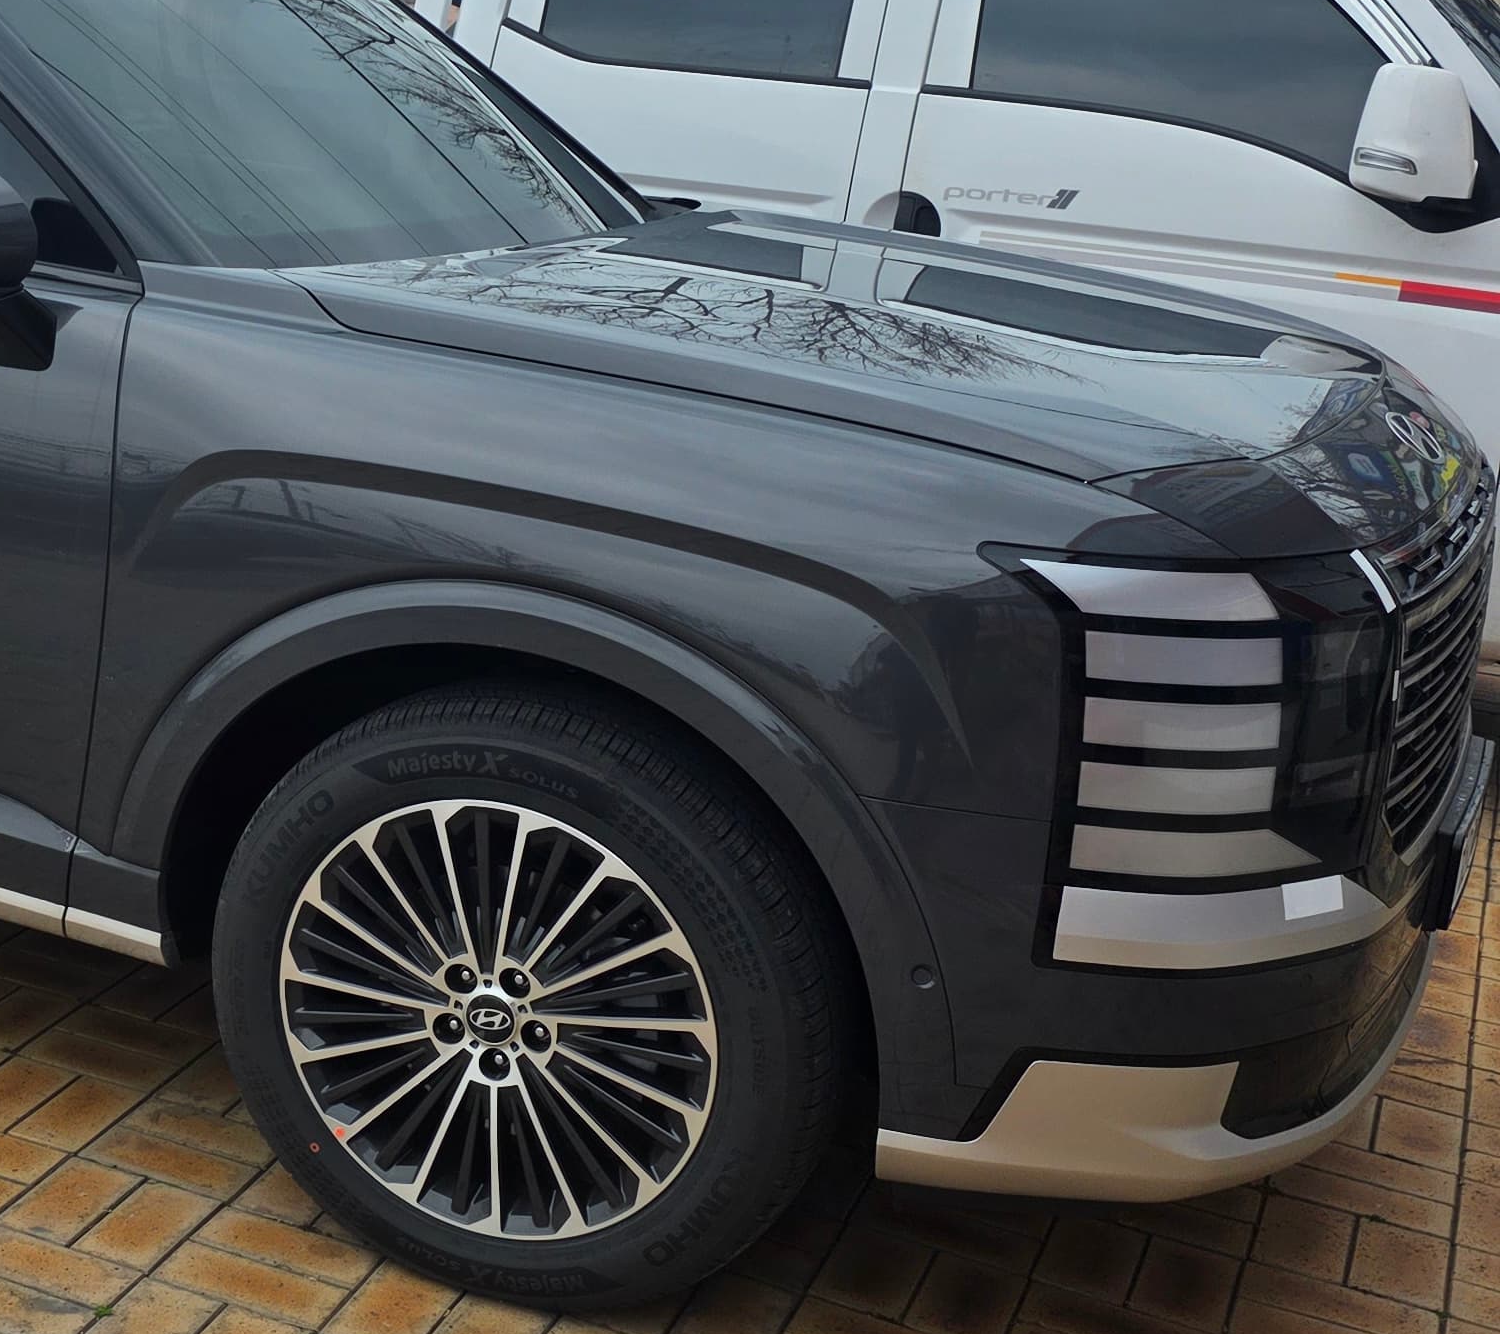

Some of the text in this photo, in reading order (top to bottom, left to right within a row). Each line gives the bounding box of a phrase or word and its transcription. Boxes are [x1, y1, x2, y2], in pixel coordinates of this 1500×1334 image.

[387, 750, 476, 779] Majesty
[508, 767, 580, 800] SOLUS
[244, 788, 336, 900] KUMHO
